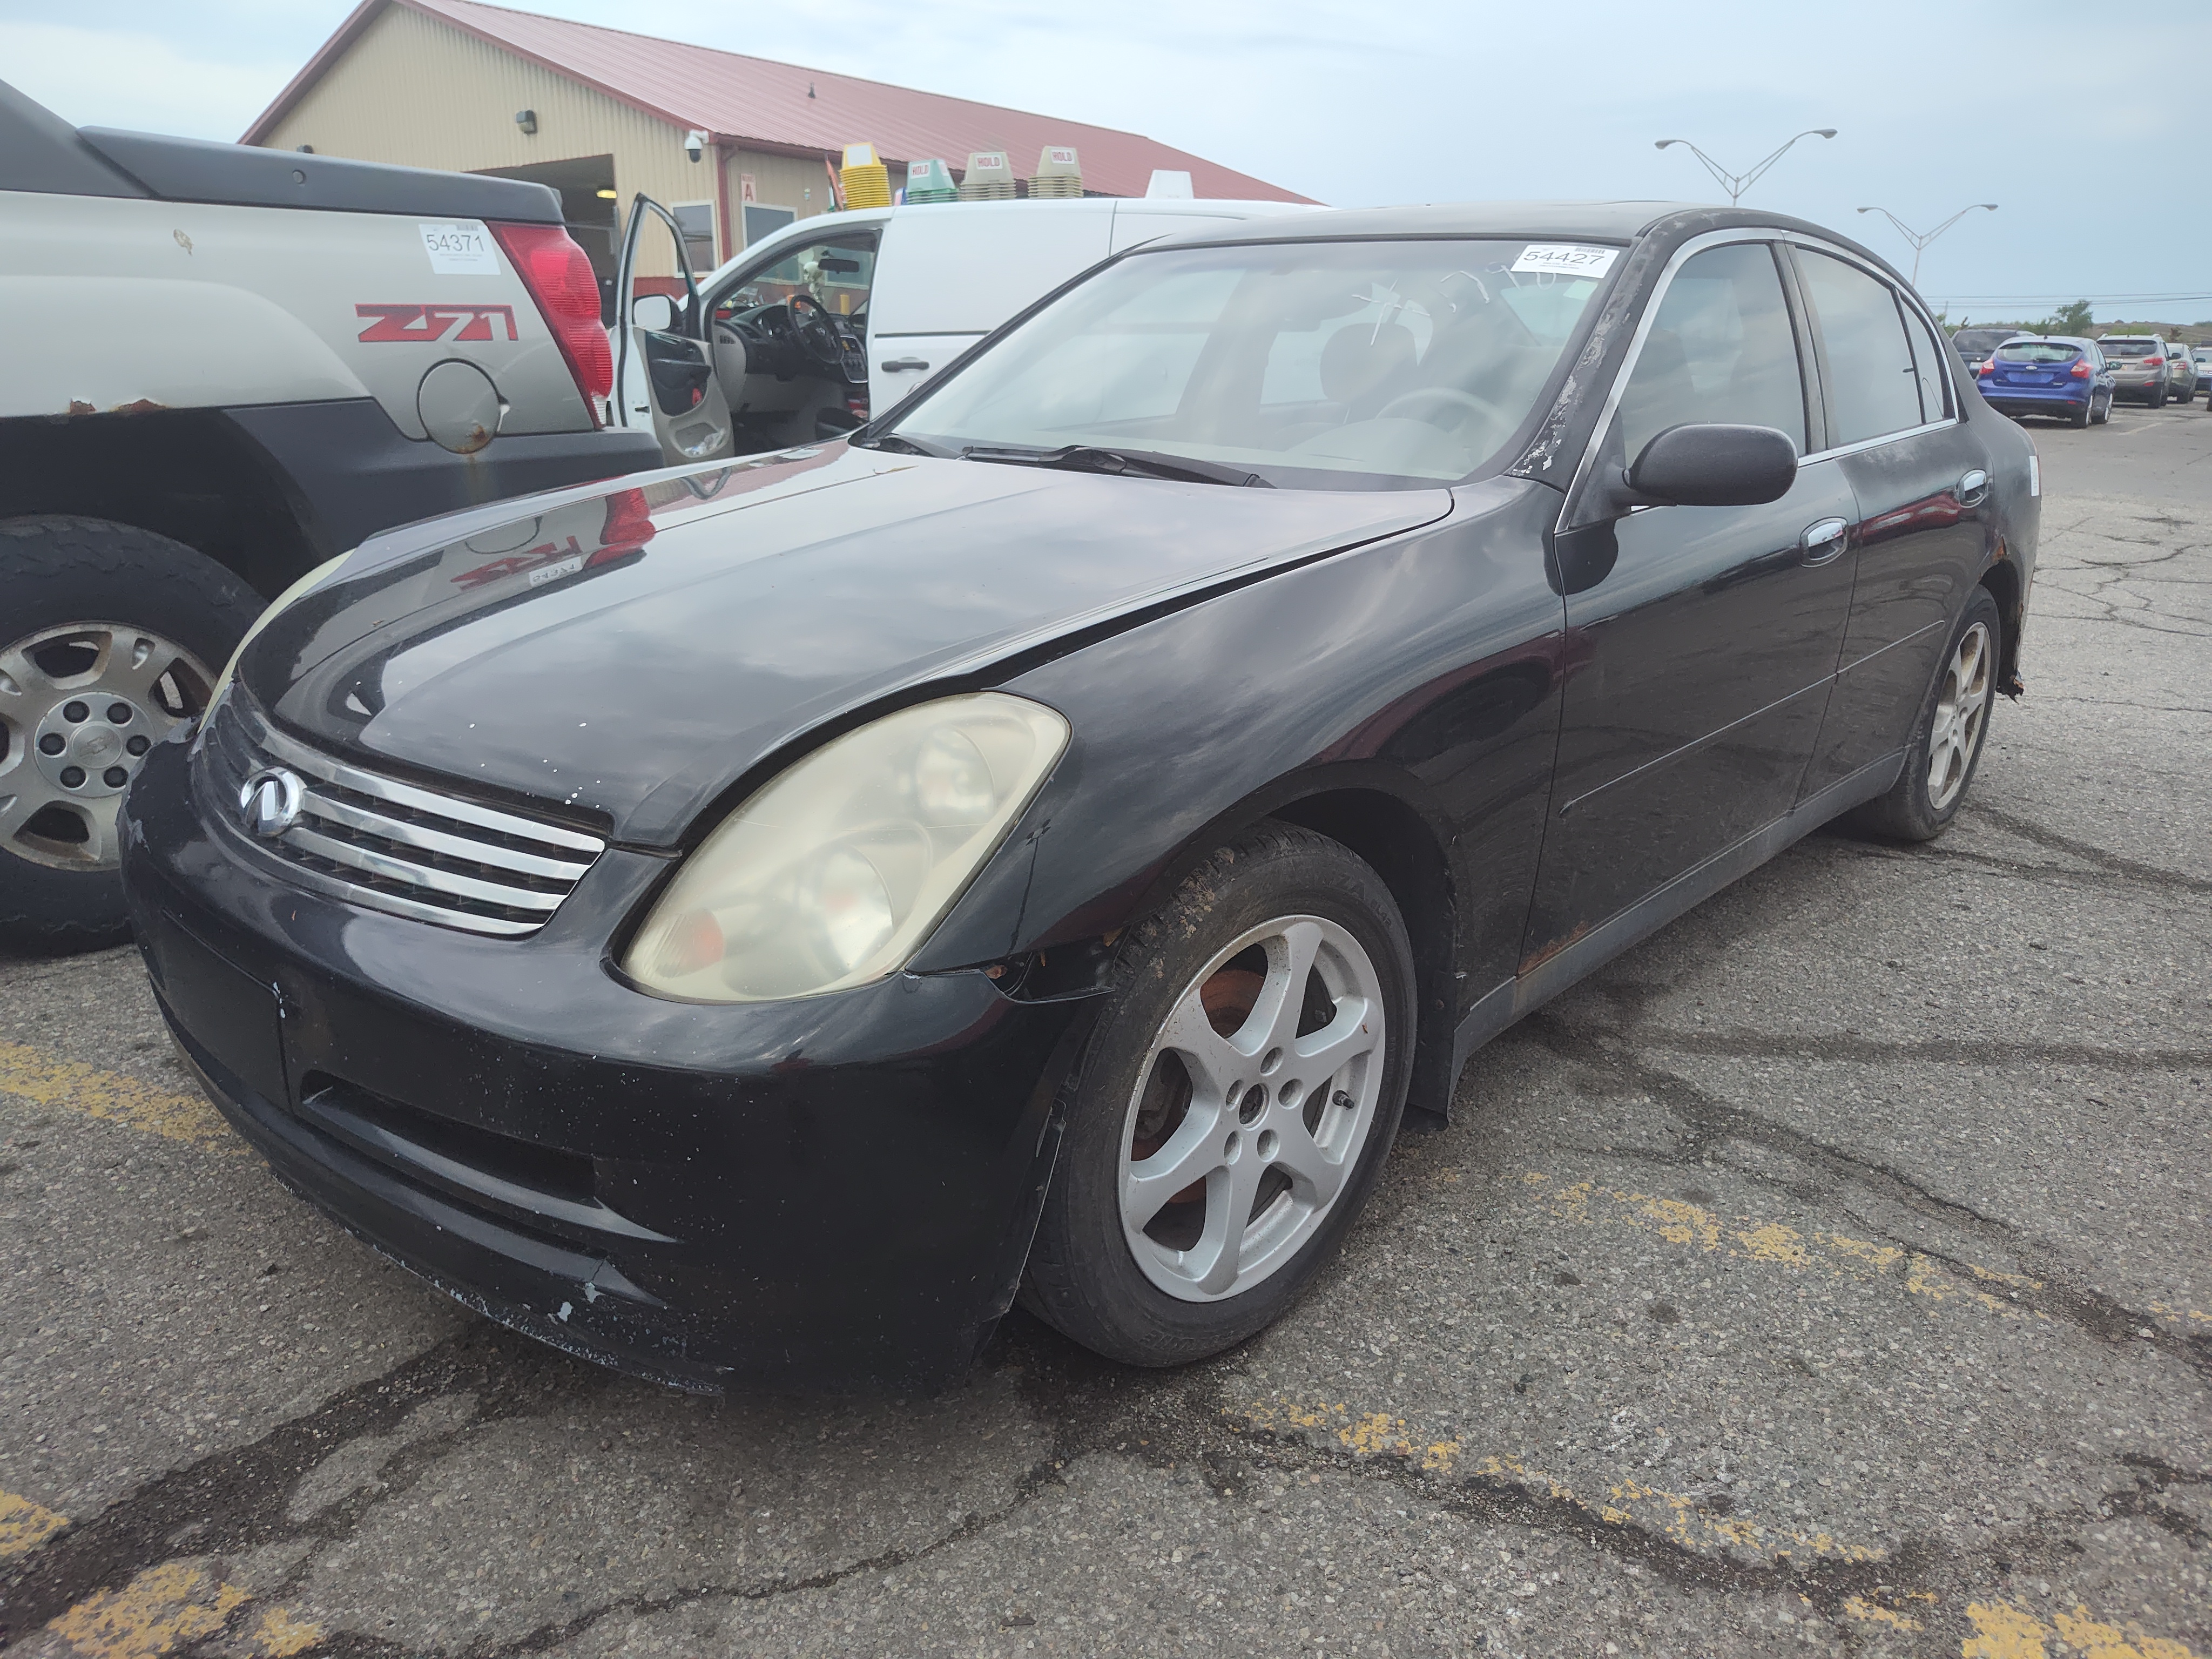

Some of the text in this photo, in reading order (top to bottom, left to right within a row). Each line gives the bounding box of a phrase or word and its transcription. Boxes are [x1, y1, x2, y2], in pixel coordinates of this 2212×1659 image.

[977, 157, 1000, 167] HOLD
[1053, 152, 1073, 161] HOLD
[913, 165, 929, 176] HOLD
[745, 184, 753, 201] A
[426, 234, 484, 252] 54371
[1523, 252, 1605, 265] 54427
[355, 304, 518, 342] Z71
